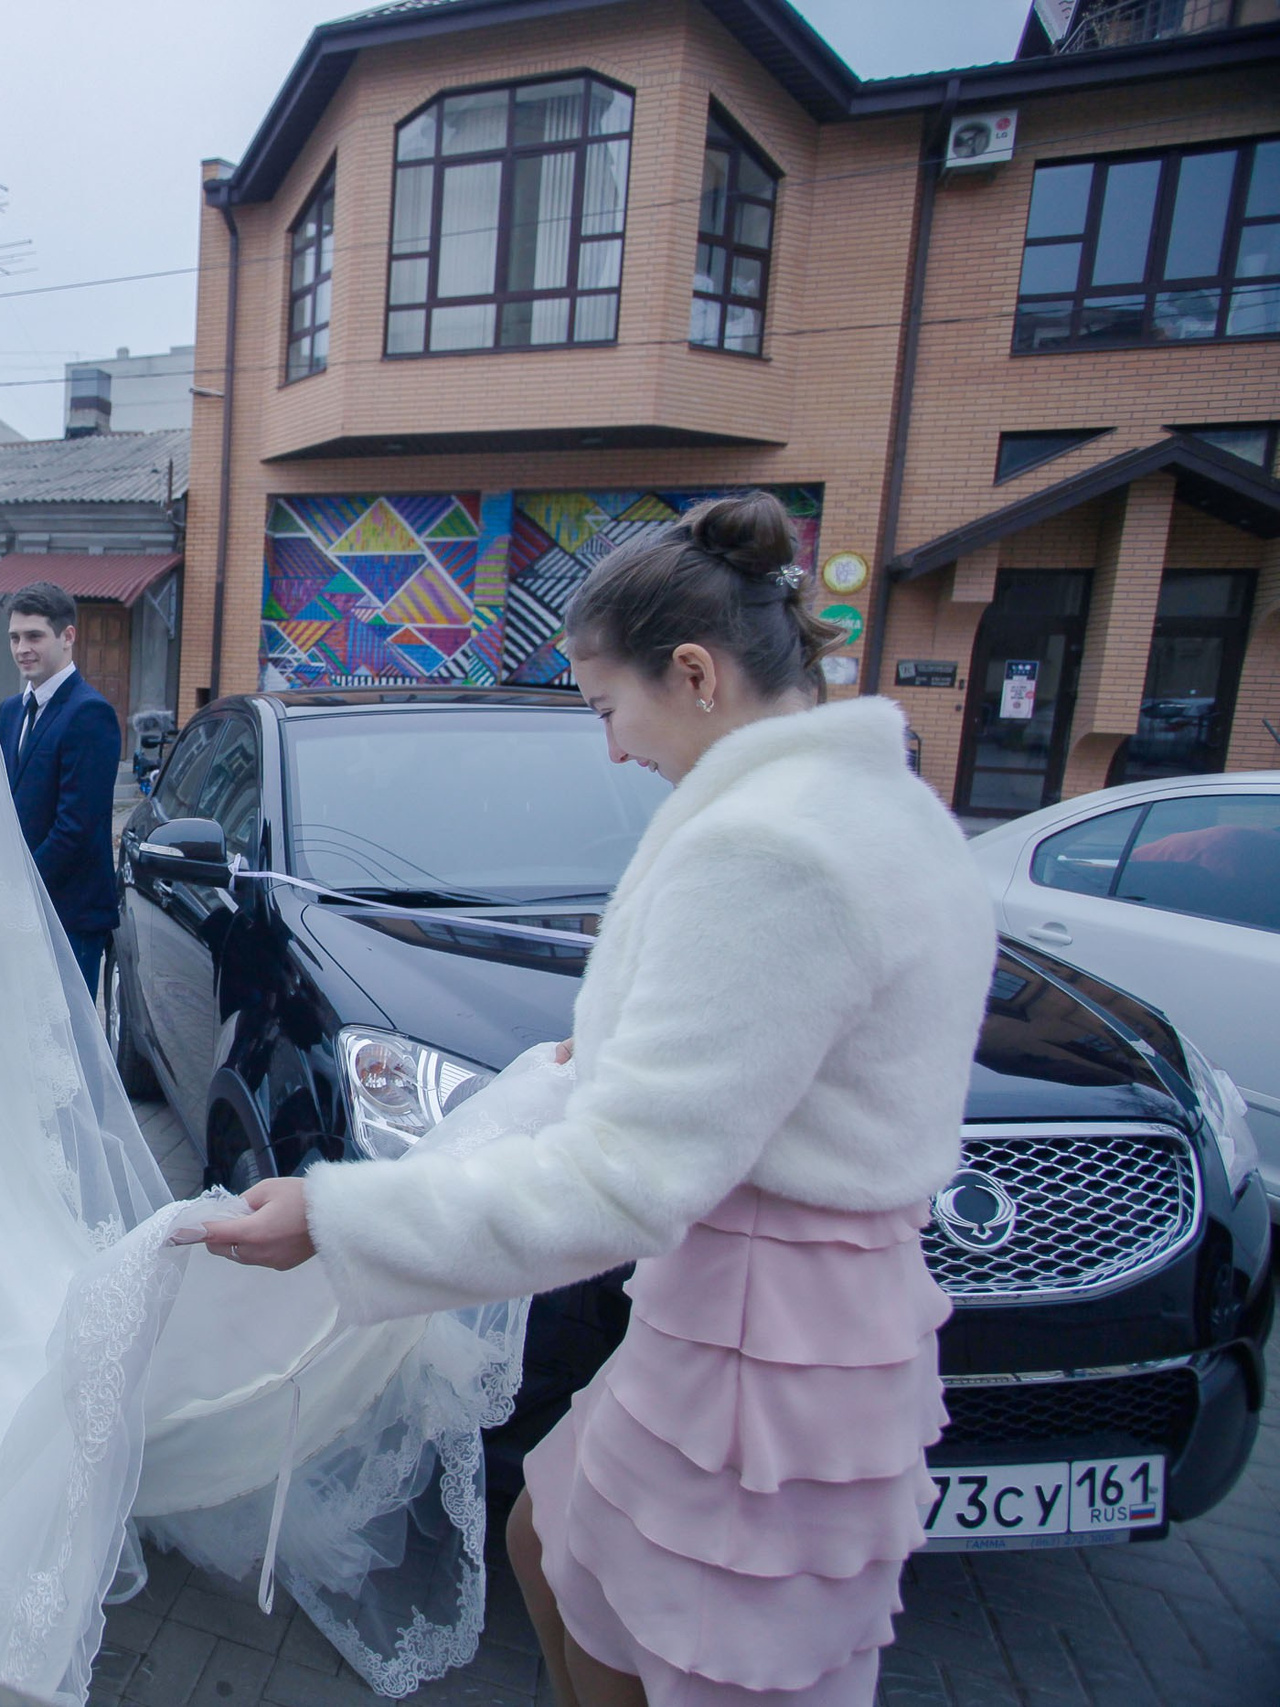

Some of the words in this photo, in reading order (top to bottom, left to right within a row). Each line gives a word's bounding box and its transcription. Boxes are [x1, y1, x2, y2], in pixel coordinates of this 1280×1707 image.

[995, 131, 1008, 140] LG
[923, 1475, 1063, 1529] 73СУ
[1075, 1462, 1150, 1508] 161
[1090, 1506, 1127, 1523] RUS
[966, 1539, 1006, 1549] ГАММА
